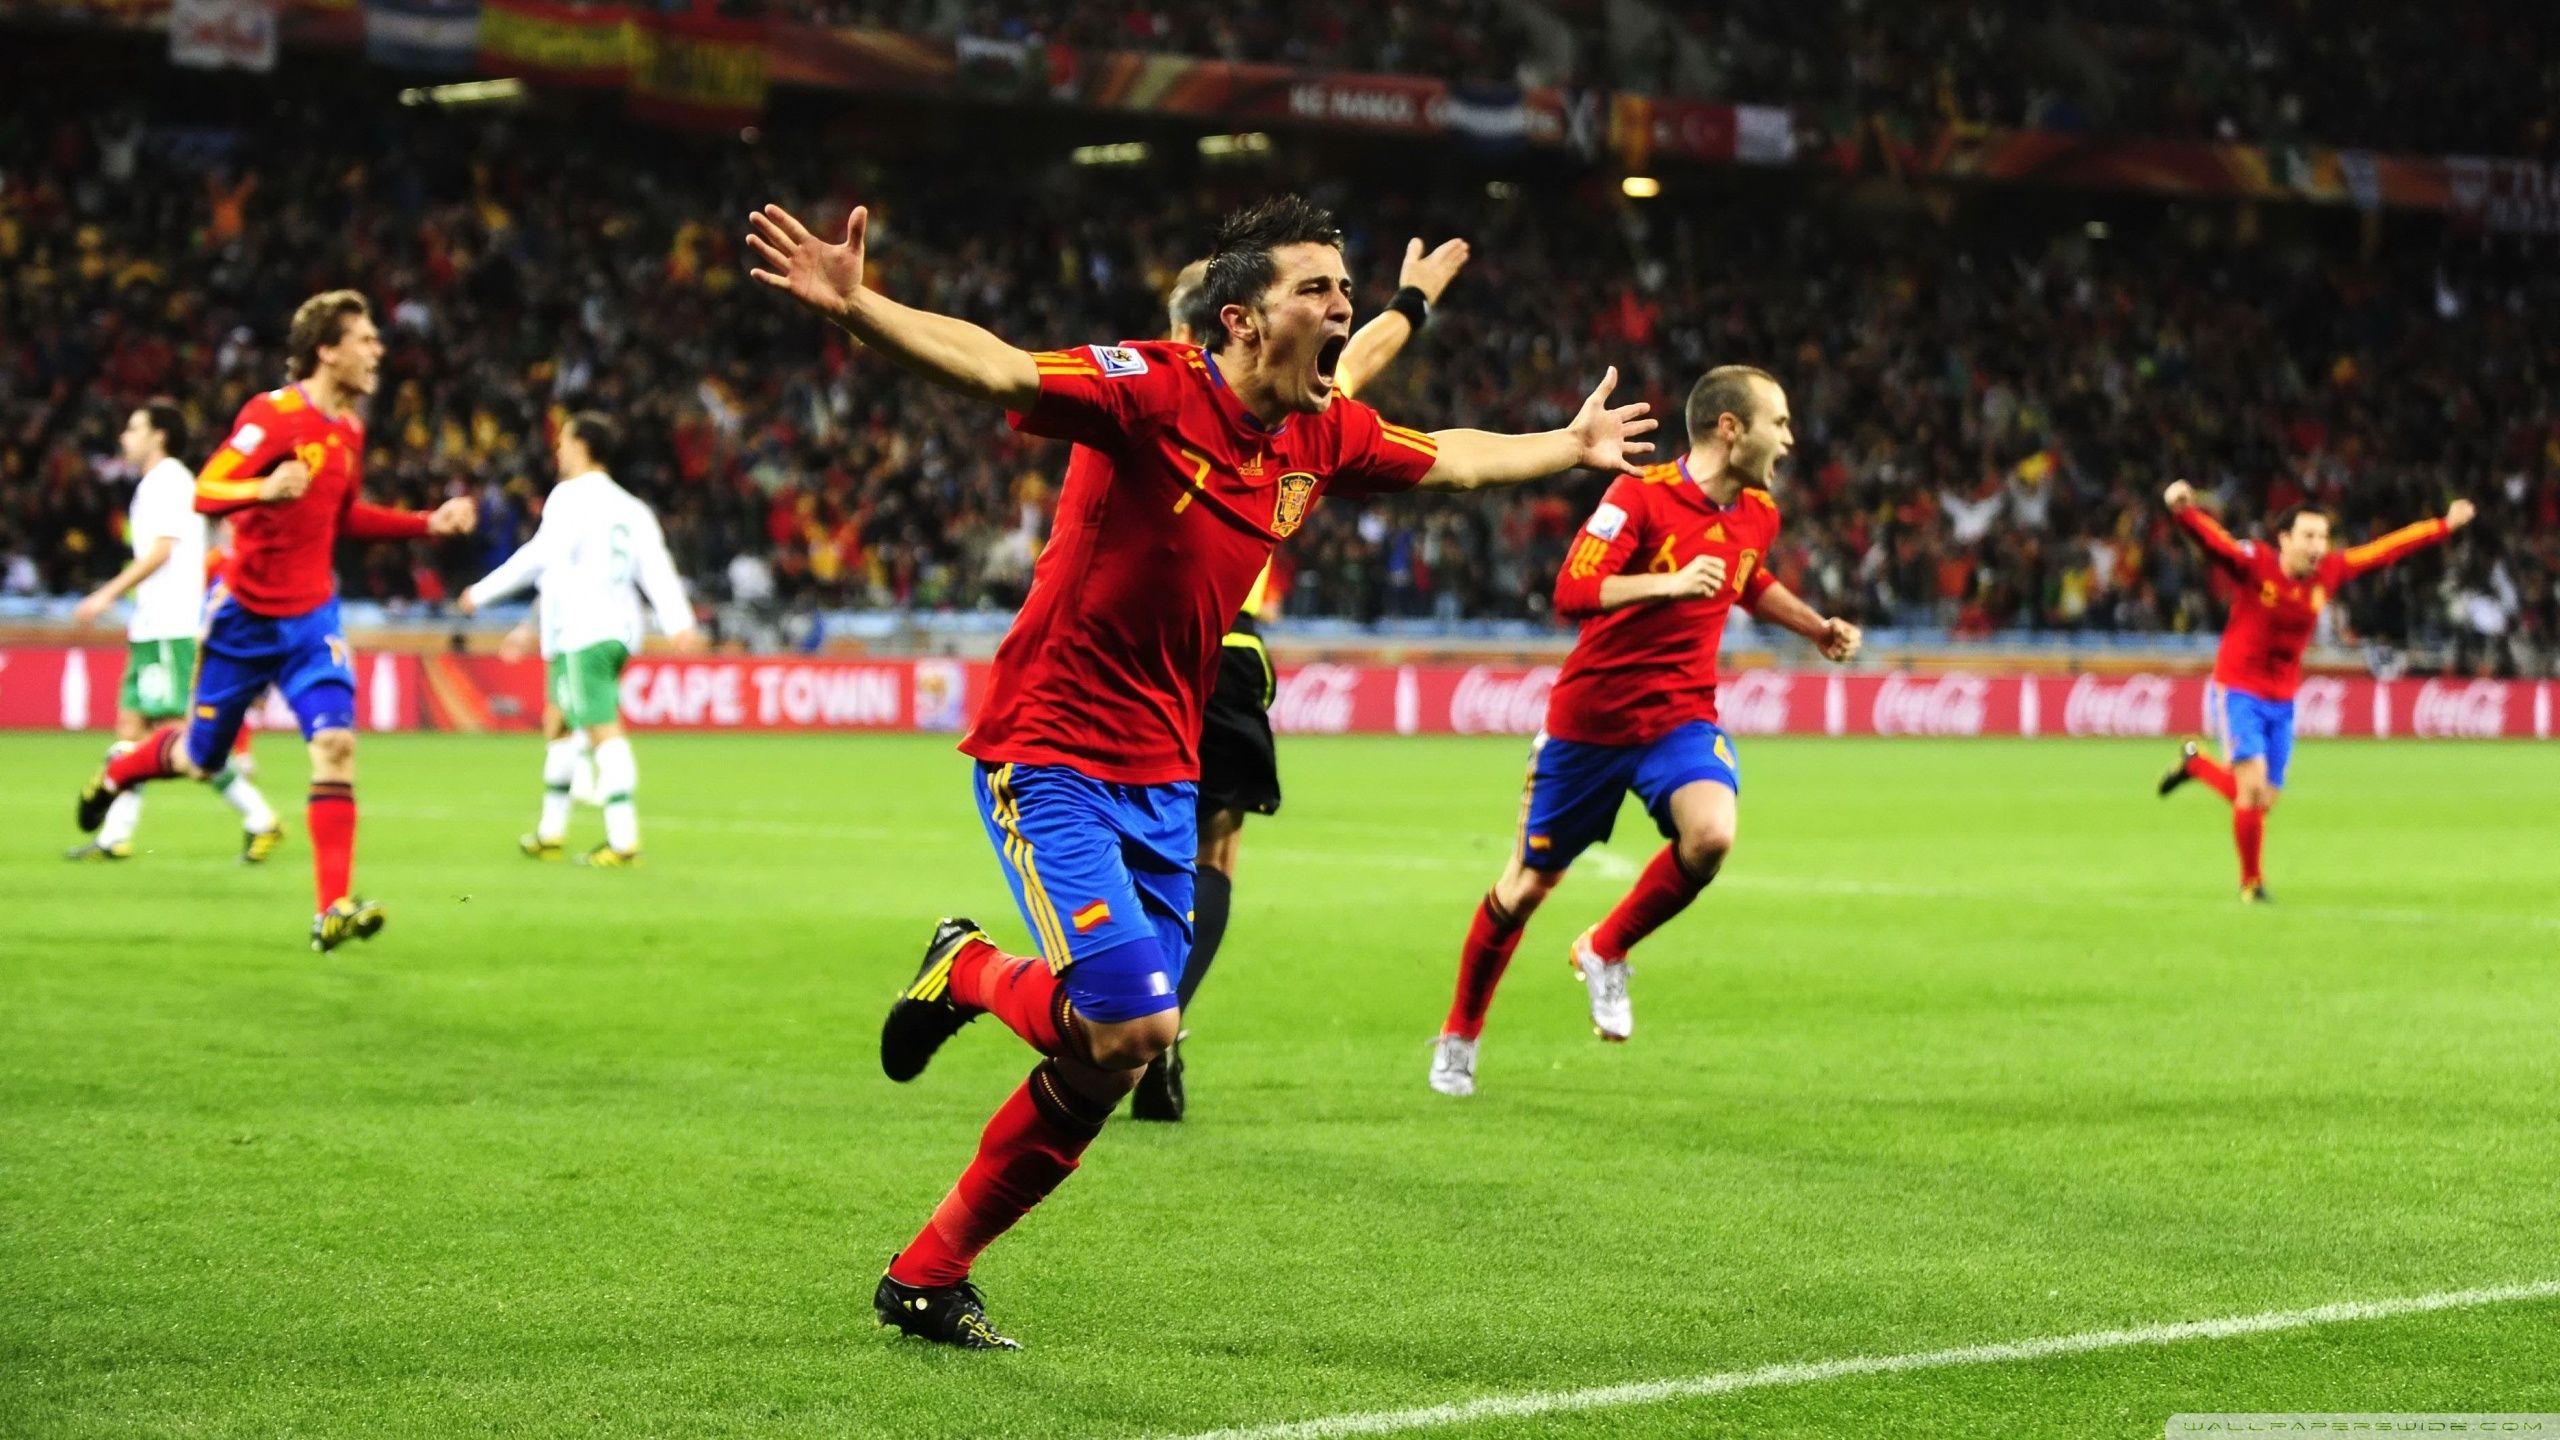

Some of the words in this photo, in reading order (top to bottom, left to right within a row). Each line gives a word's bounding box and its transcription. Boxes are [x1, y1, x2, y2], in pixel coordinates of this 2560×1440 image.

[1173, 449, 1211, 515] 7
[1649, 533, 1677, 575] 6
[619, 663, 744, 725] CAPE
[752, 664, 899, 725] TOWN
